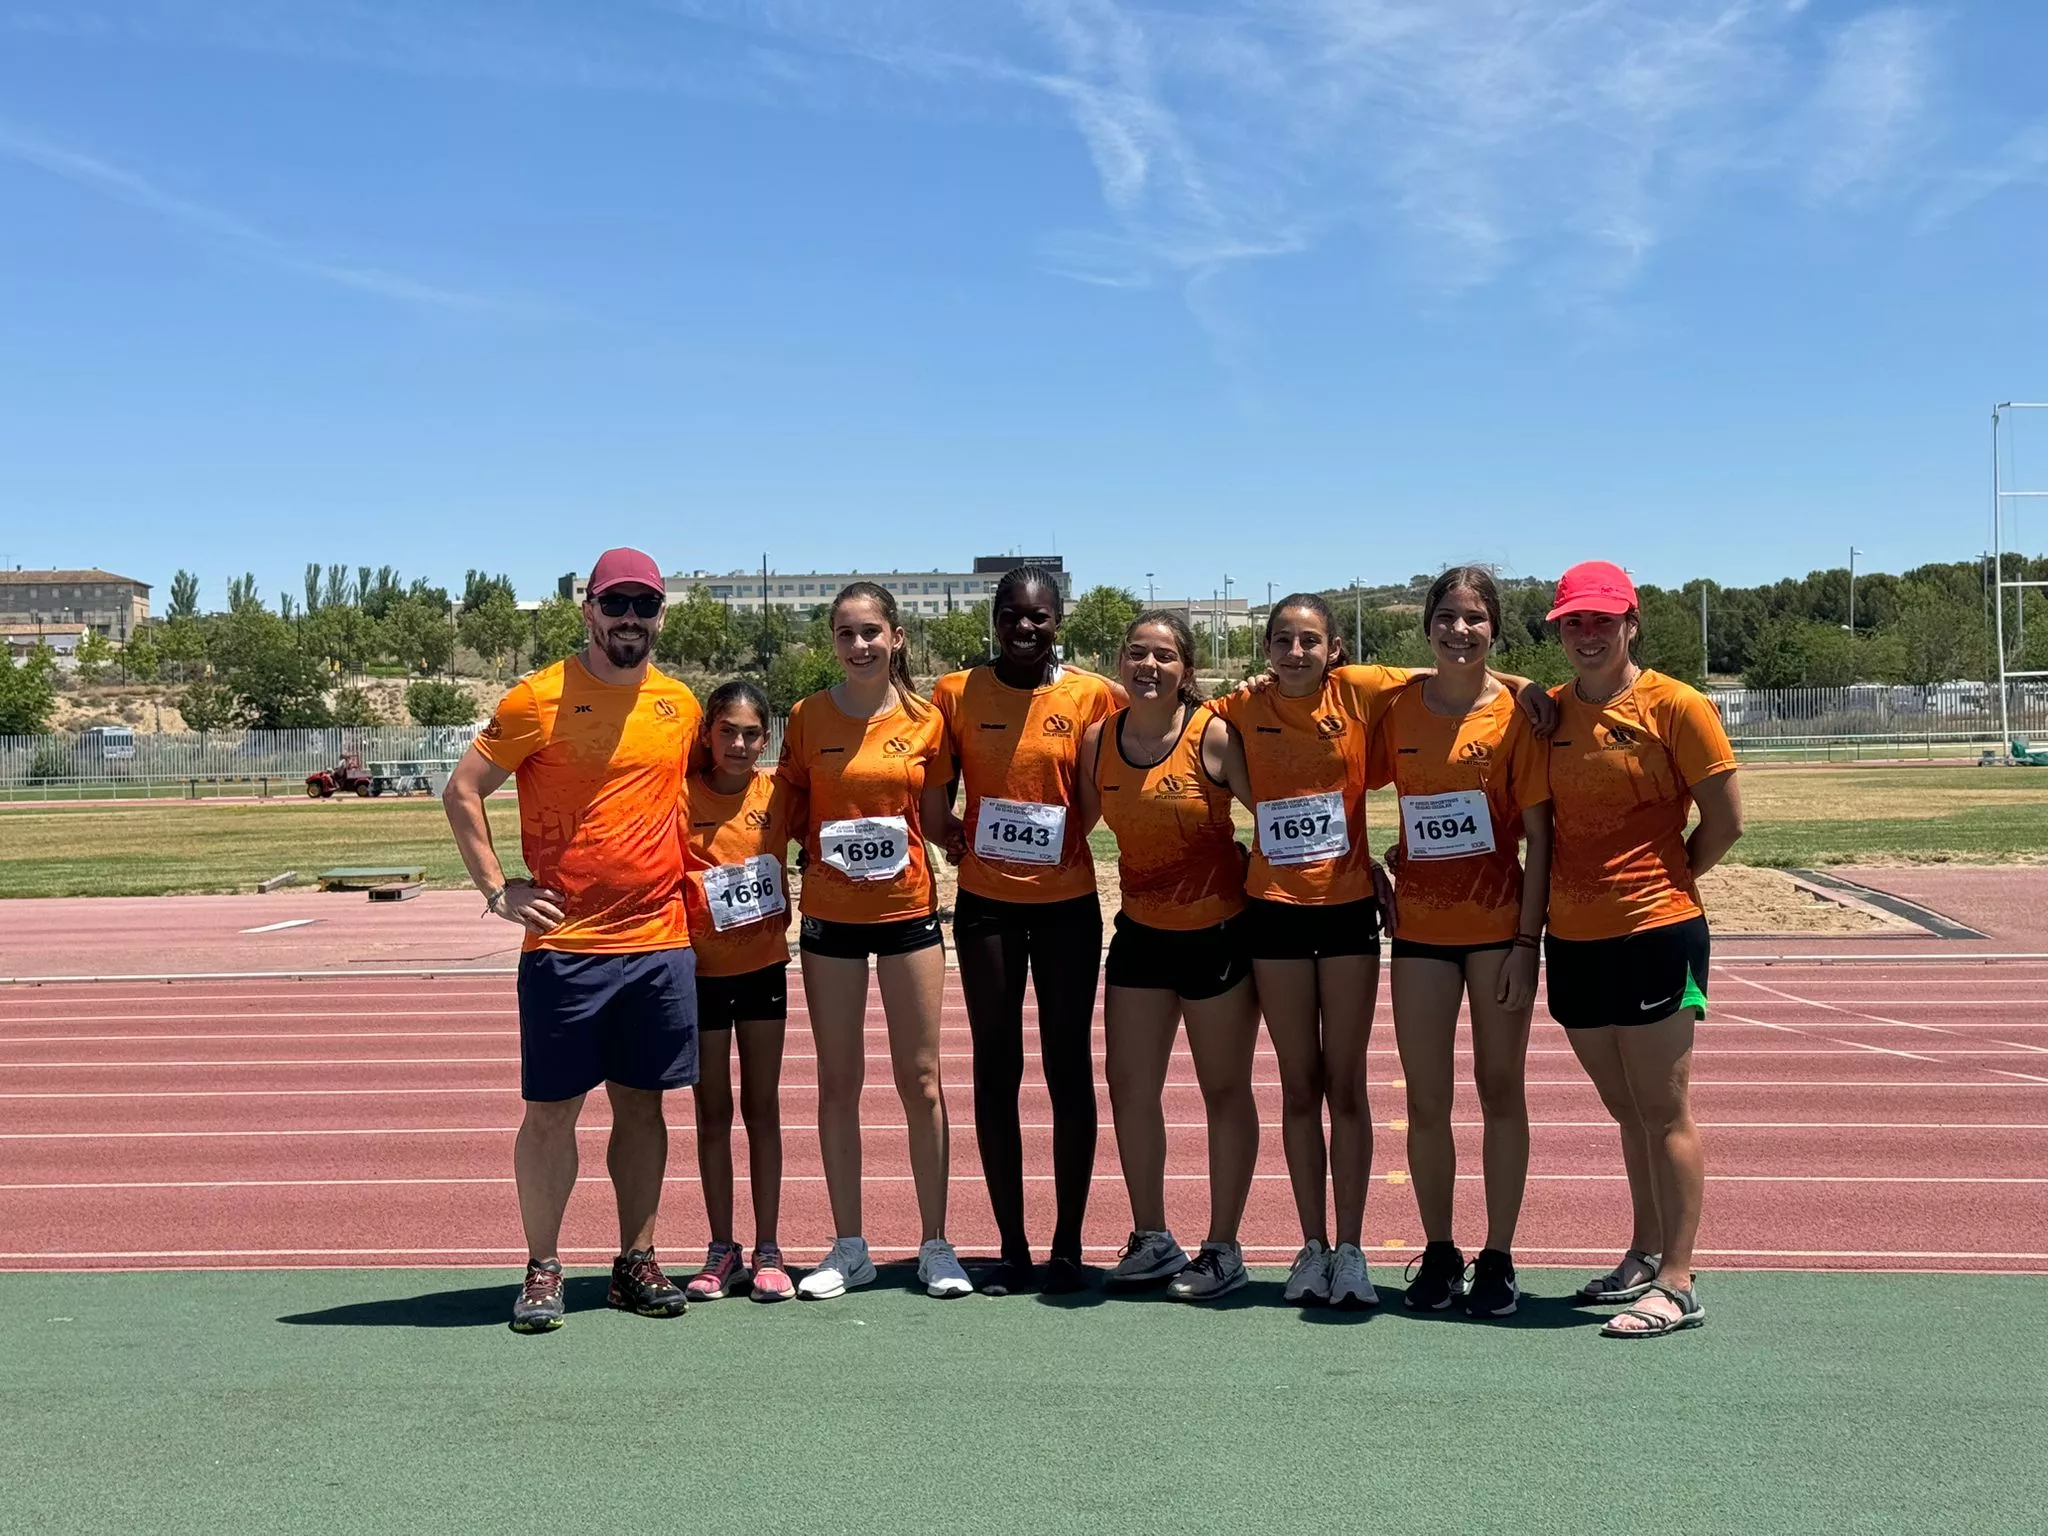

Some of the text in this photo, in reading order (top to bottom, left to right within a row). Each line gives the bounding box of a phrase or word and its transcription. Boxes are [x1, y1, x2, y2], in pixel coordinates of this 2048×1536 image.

[988, 822, 1050, 847] 1843
[1269, 814, 1331, 841] 1697
[1414, 815, 1478, 840] 1694
[833, 840, 895, 862] 1698
[720, 878, 774, 908] 1696
